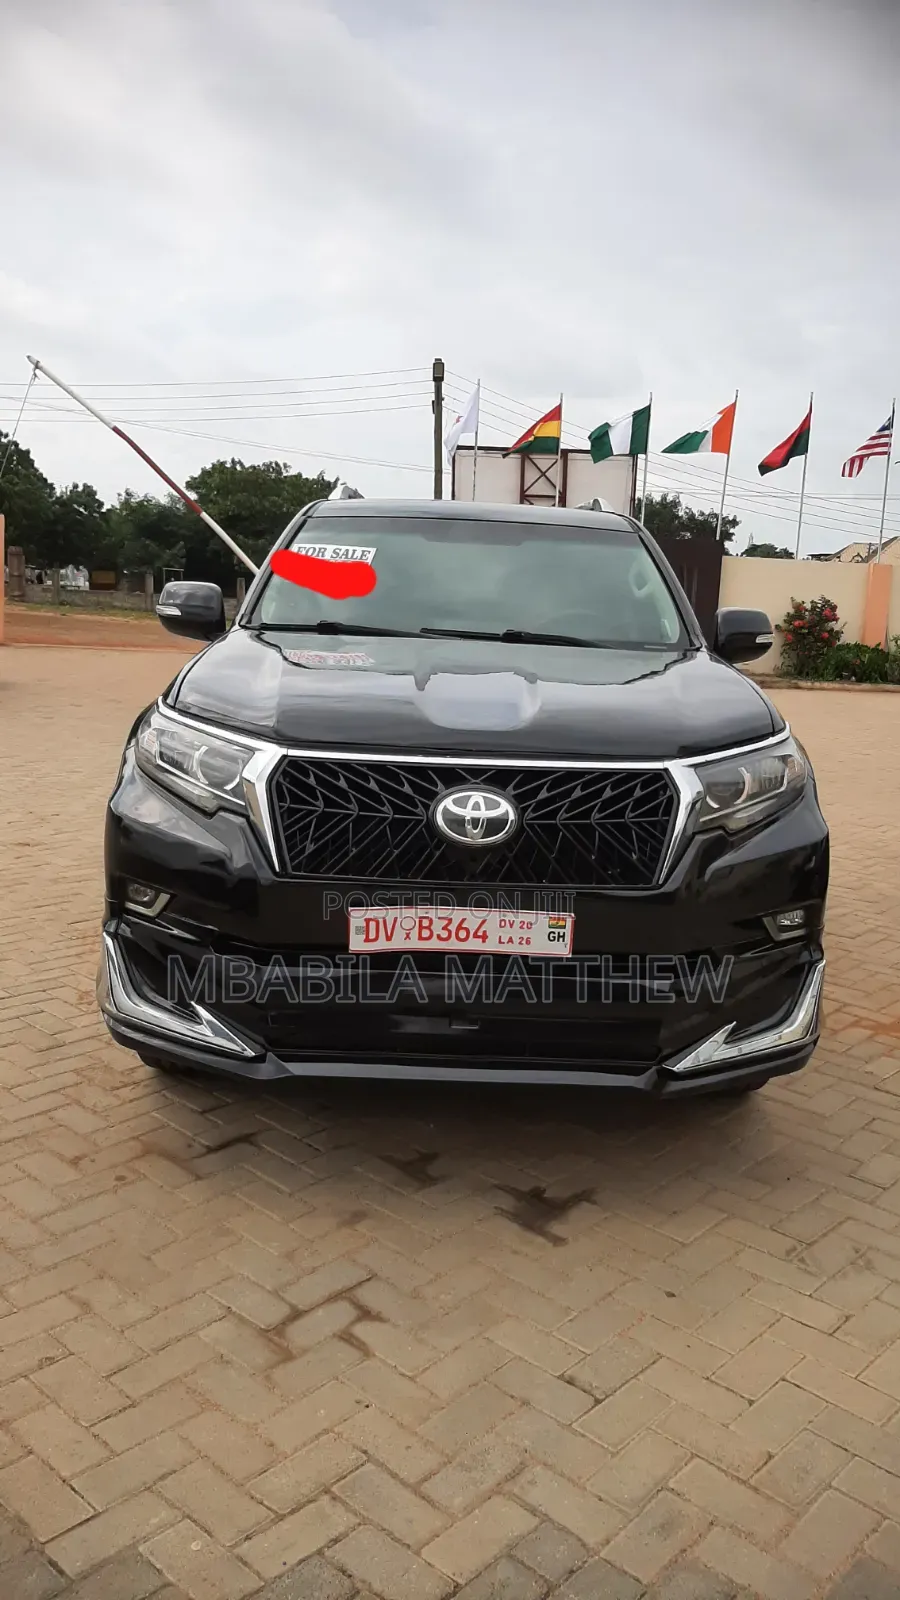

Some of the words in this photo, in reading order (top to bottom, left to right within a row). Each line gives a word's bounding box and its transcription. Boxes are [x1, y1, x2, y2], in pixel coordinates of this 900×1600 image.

[297, 546, 328, 558] FOR
[330, 547, 372, 561] SALE
[363, 916, 399, 943] DV
[417, 915, 489, 943] B364
[498, 919, 516, 929] DV
[498, 935, 515, 945] LA
[518, 936, 532, 946] 26
[547, 930, 567, 943] GH
